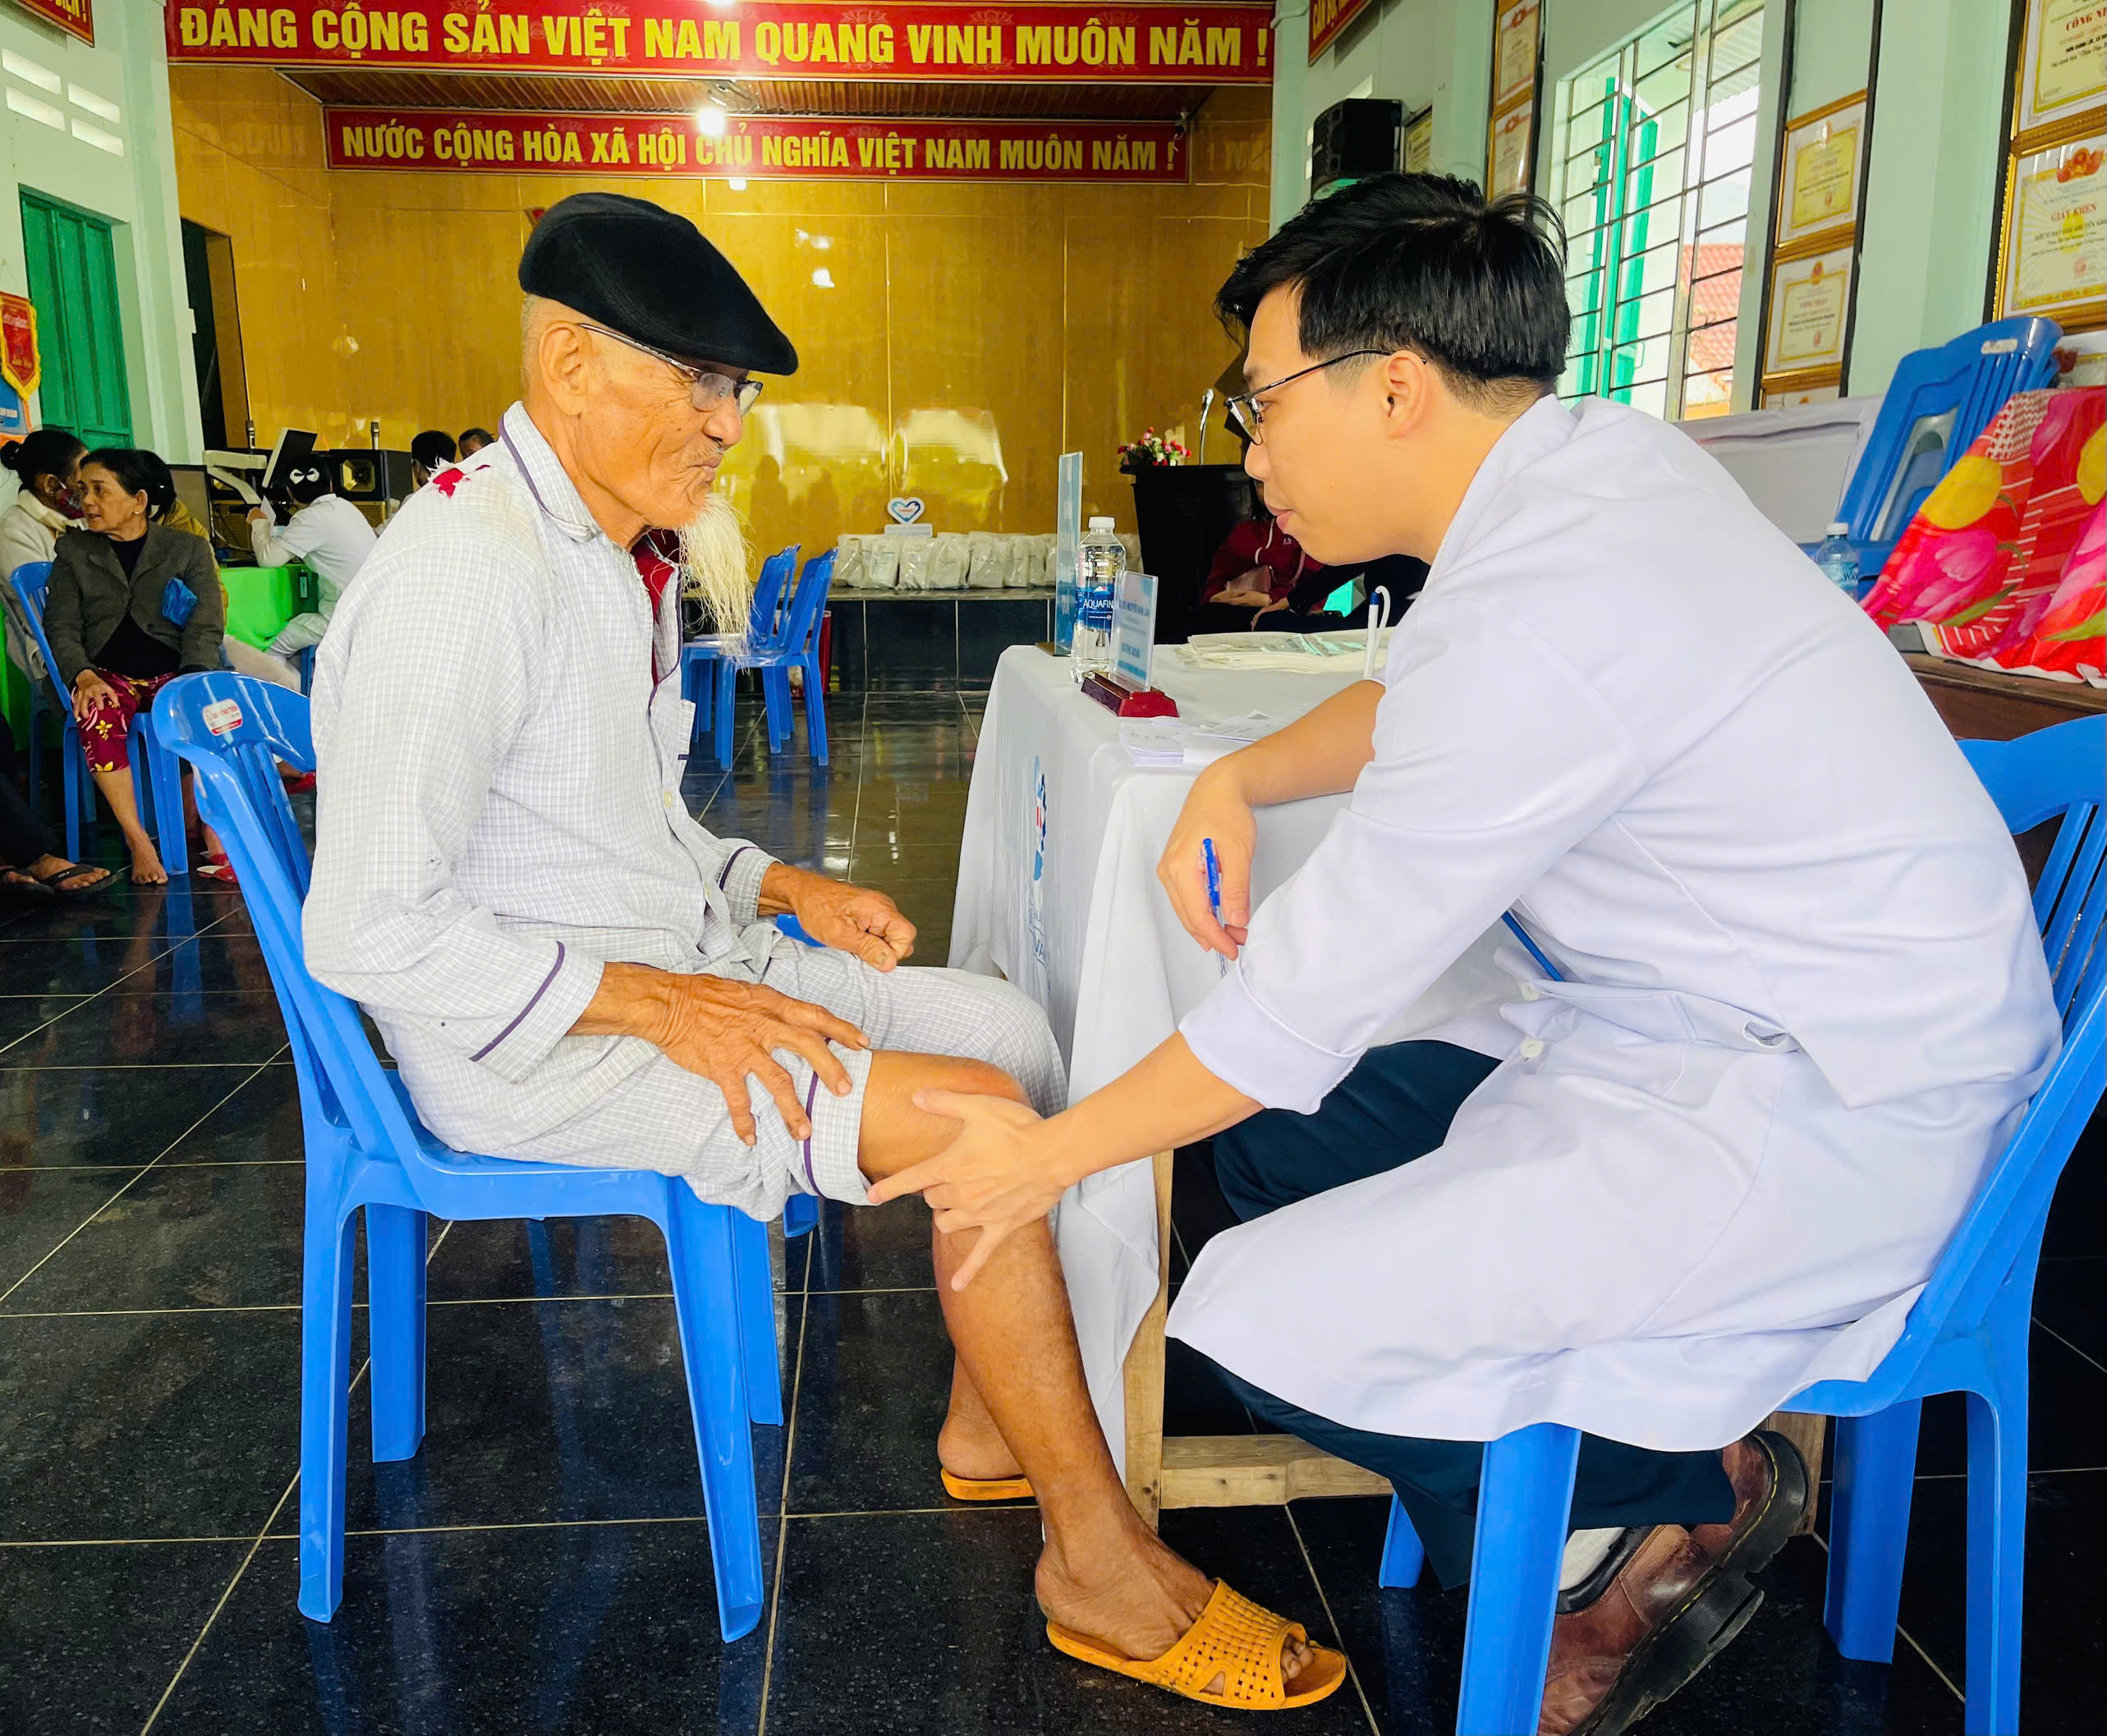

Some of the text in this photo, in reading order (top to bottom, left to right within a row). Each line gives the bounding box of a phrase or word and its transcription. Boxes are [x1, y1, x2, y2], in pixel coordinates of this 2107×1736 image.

[312, 2, 429, 58] CỘNG
[443, 0, 531, 54] SẢN
[542, 8, 631, 66] VIỆT
[645, 20, 741, 61] NAM
[755, 22, 894, 66] QUANG
[907, 25, 1003, 64] VINH
[1016, 17, 1136, 65] MUÔN
[1150, 19, 1241, 66] NĂM
[1256, 29, 1268, 66] !
[342, 118, 1175, 175] NƯỚC CỘNG HÒA XÃ HỘI CHỦ NGHĨA VIỆT NAM MUÔN NĂM !
